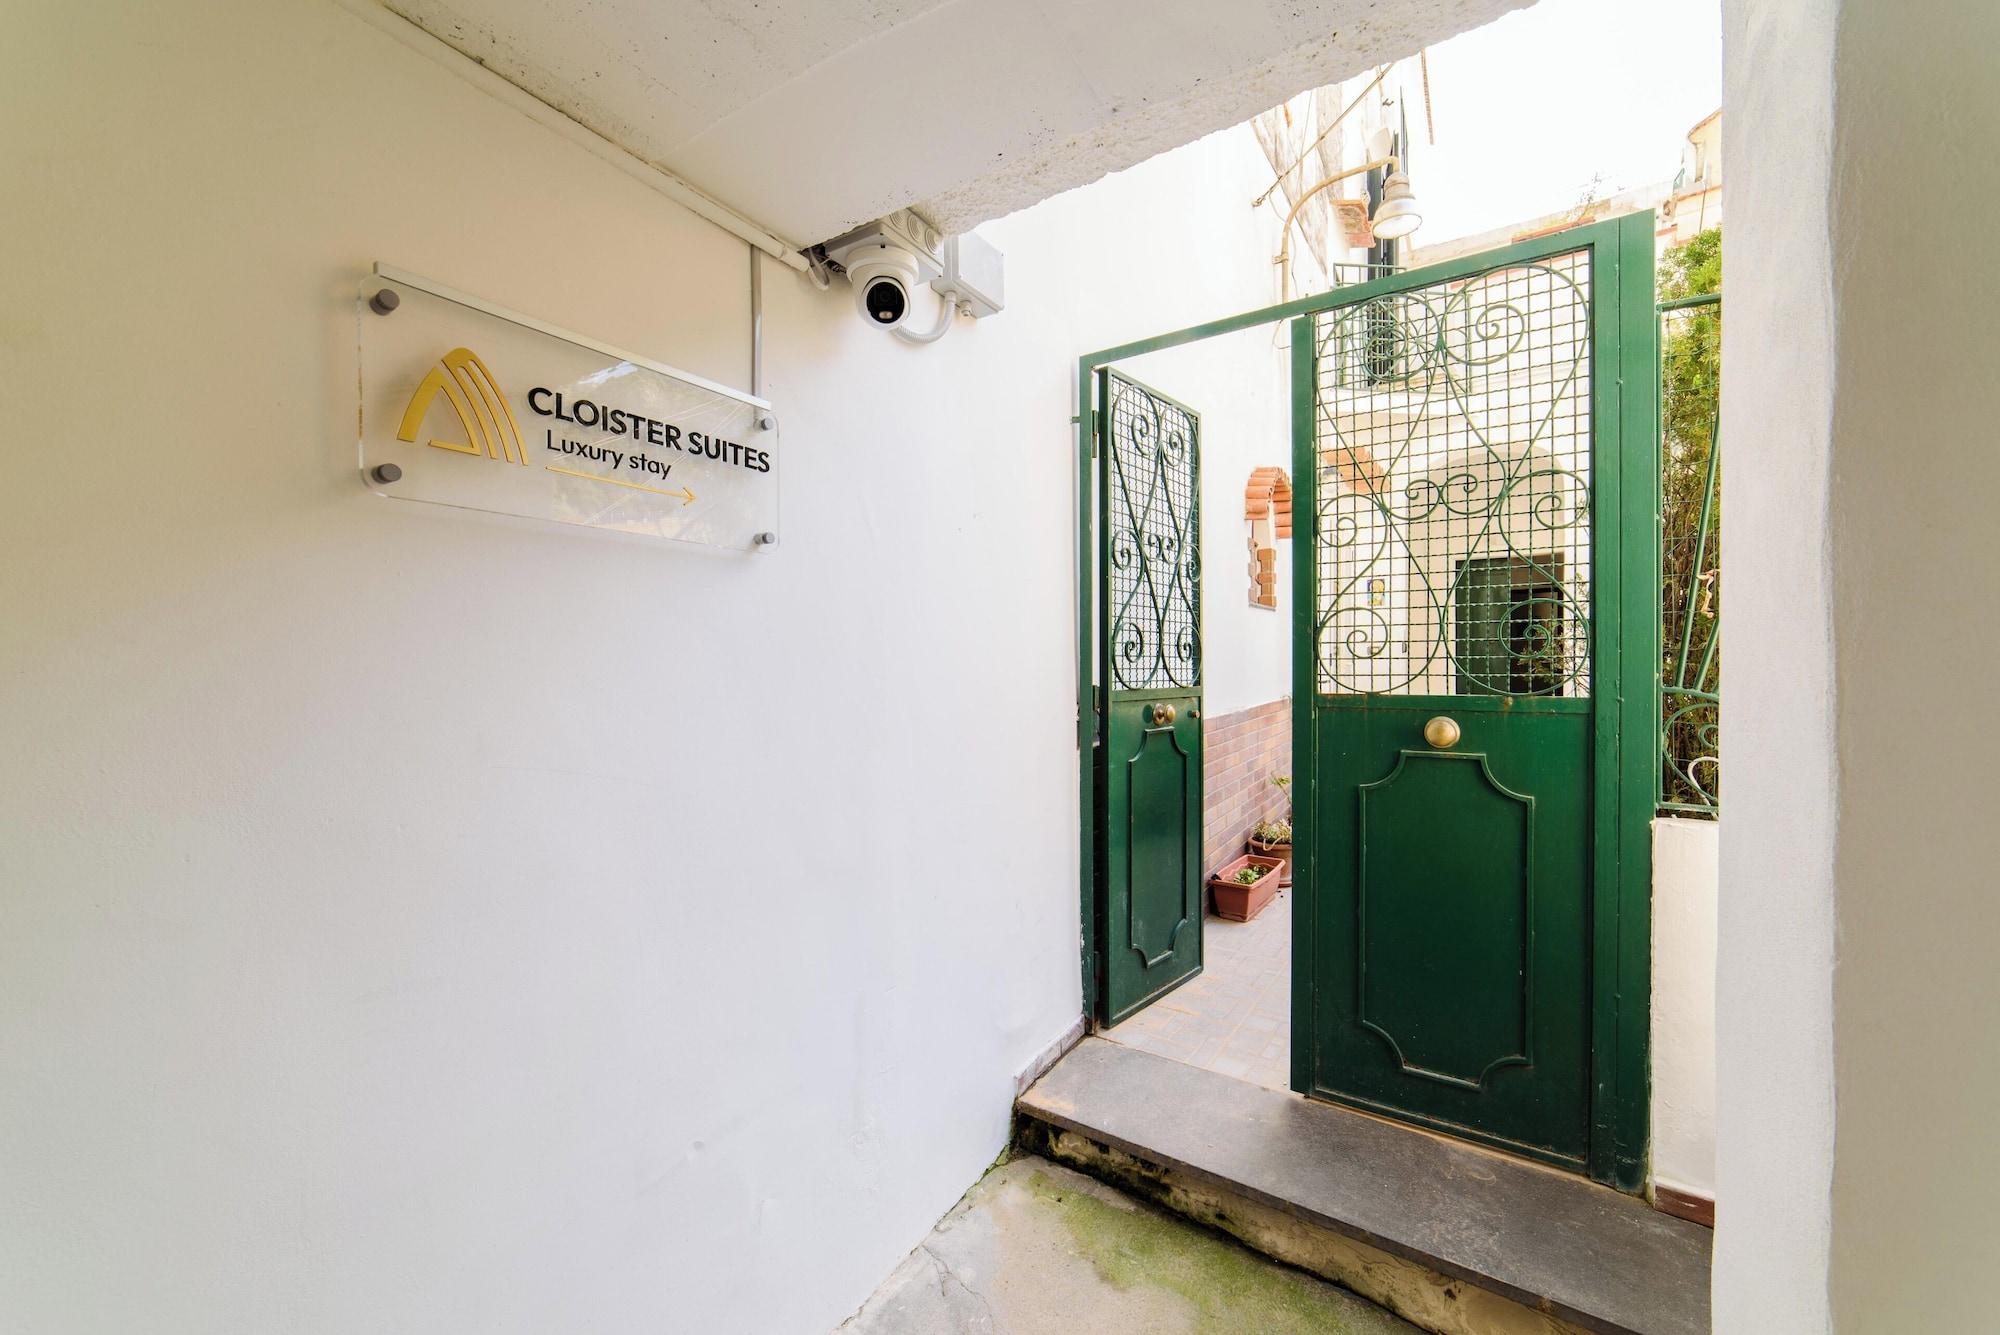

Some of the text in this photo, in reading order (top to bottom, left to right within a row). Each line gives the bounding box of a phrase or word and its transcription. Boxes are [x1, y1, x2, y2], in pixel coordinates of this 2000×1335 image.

[527, 387, 770, 473] CLOISTER SUITES
[546, 429, 672, 480] Luxury stay
